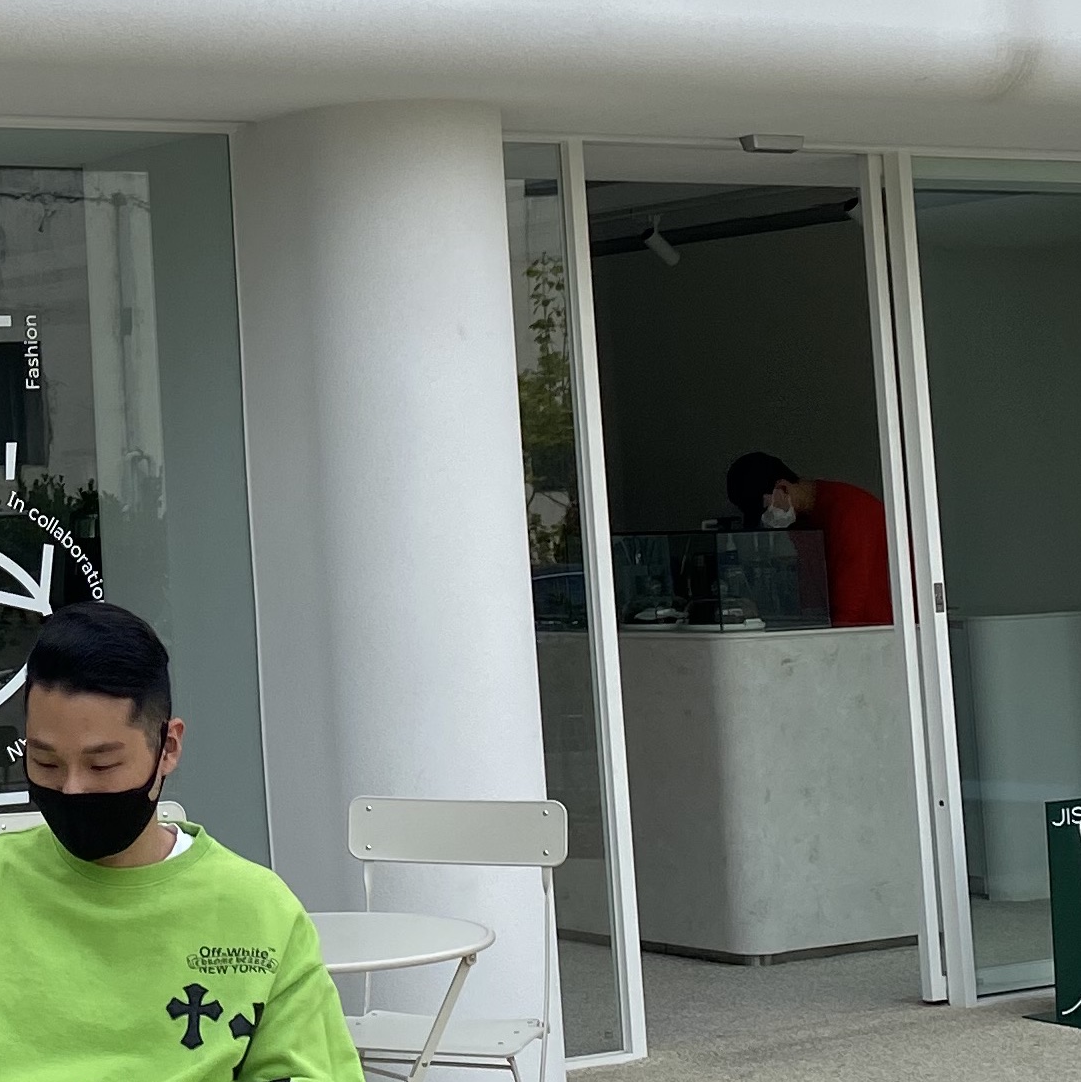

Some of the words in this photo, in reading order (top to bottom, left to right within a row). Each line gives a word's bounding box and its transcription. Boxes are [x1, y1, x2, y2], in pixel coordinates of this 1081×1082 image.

[24, 314, 41, 390] Fashion
[7, 490, 25, 513] In
[28, 508, 105, 603] collaboratio
[199, 965, 228, 975] NEW
[231, 964, 267, 975] YORK
